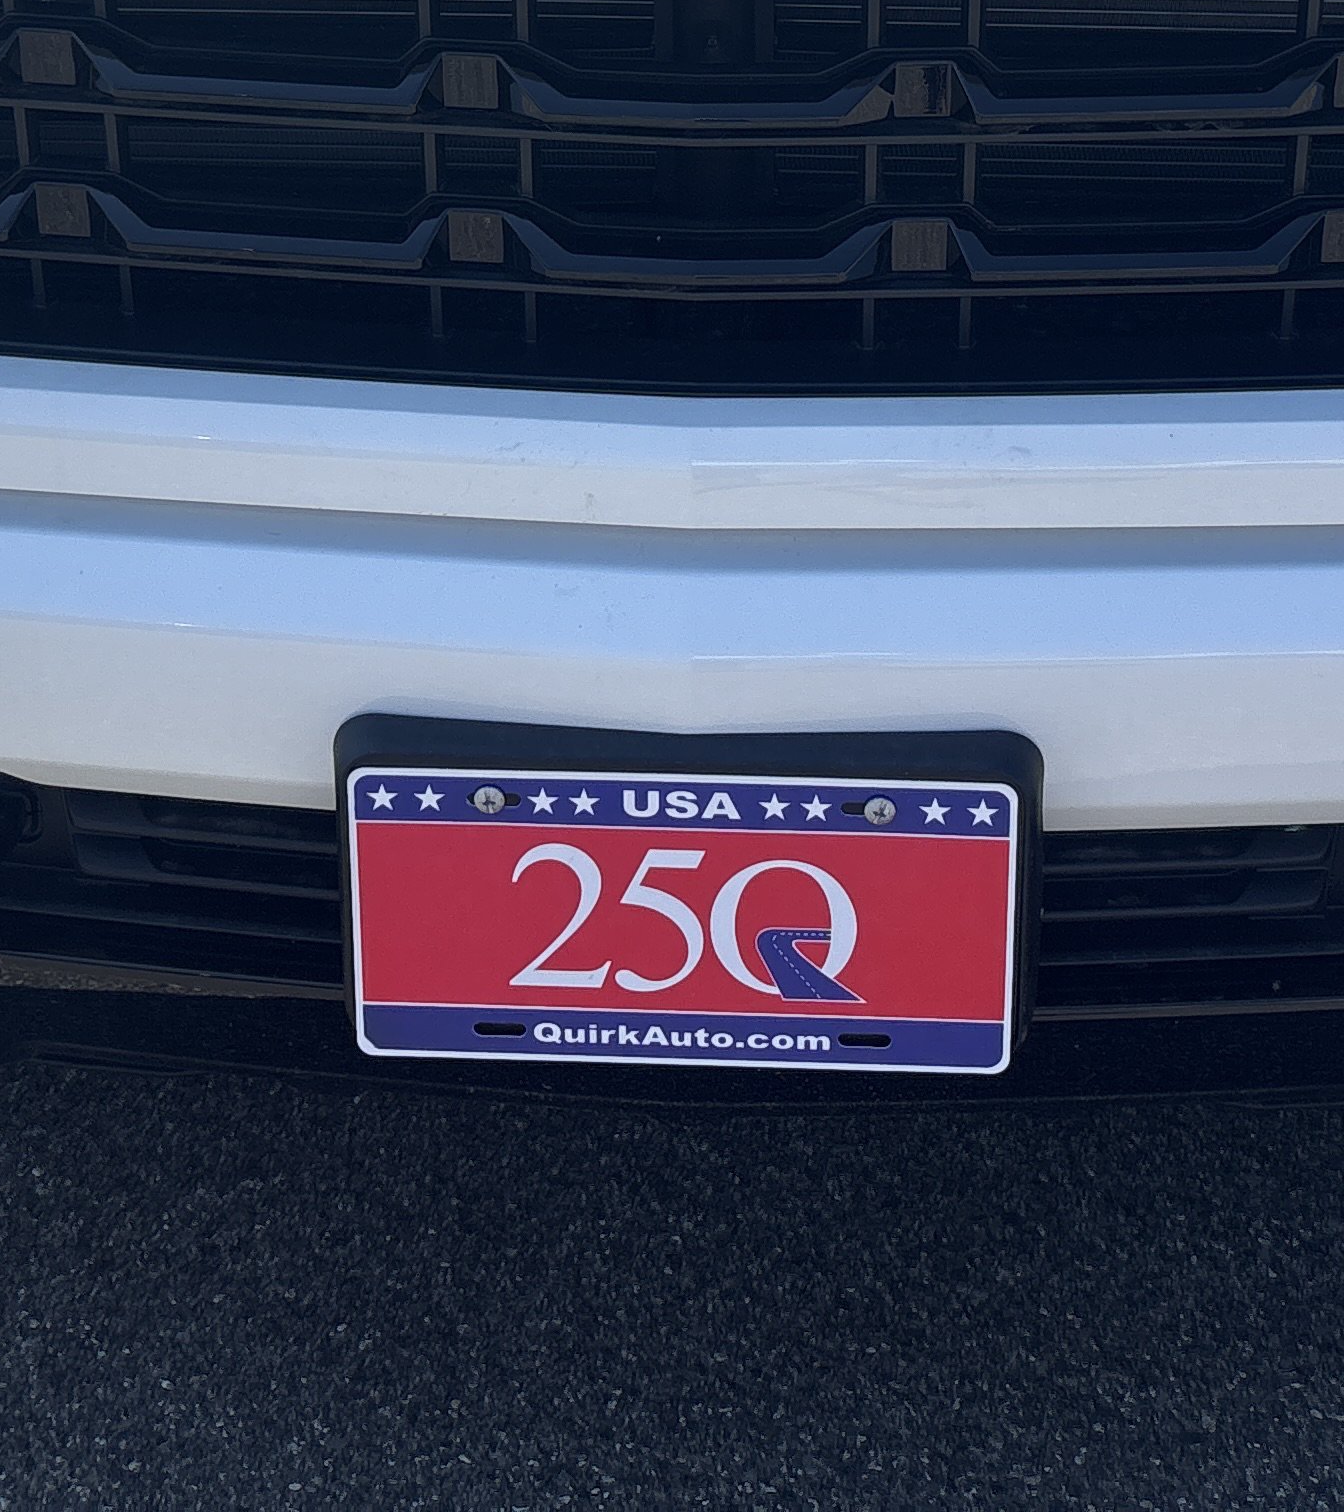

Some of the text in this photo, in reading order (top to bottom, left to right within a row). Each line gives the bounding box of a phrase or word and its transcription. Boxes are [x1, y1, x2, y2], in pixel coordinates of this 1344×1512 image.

[622, 789, 742, 821] USA
[509, 842, 867, 1004] 25Q
[533, 1022, 831, 1053] QuirkAuto.com
